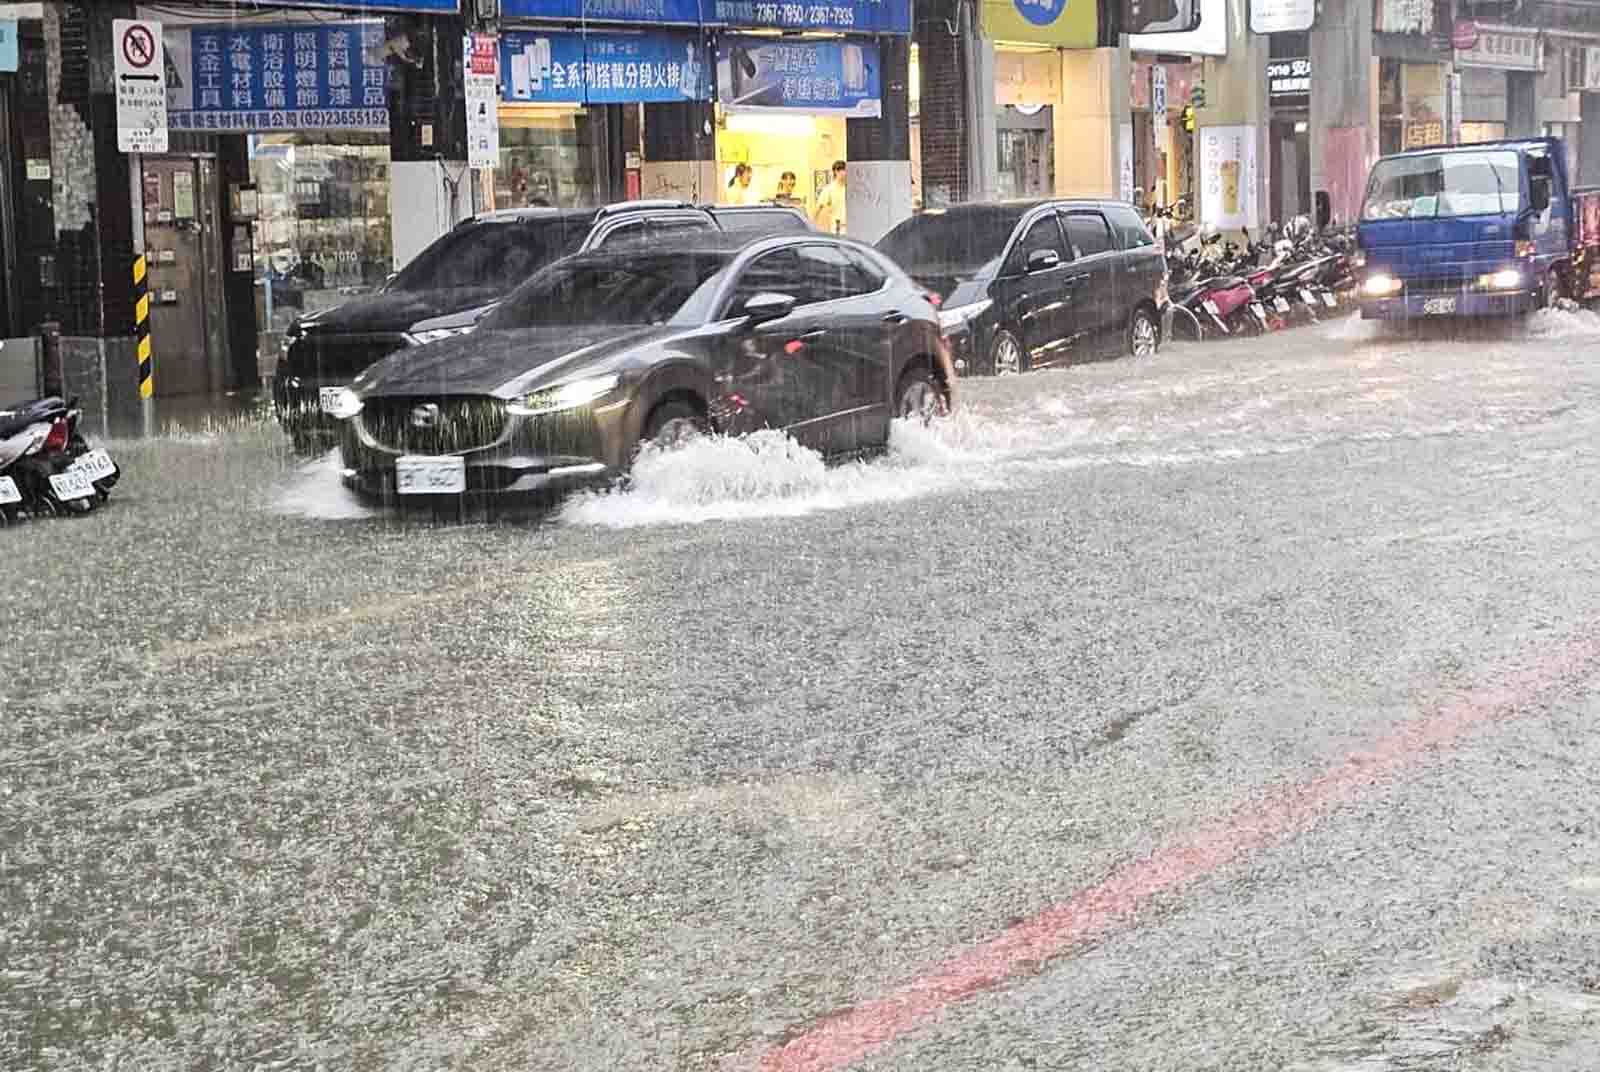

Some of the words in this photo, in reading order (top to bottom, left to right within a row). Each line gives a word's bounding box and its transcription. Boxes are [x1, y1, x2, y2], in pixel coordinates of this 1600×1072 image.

[200, 34, 223, 108] 五金工具
[231, 34, 252, 108] 水電材料
[263, 33, 286, 107] 衛浴設備
[293, 32, 319, 107] 照明燈飾
